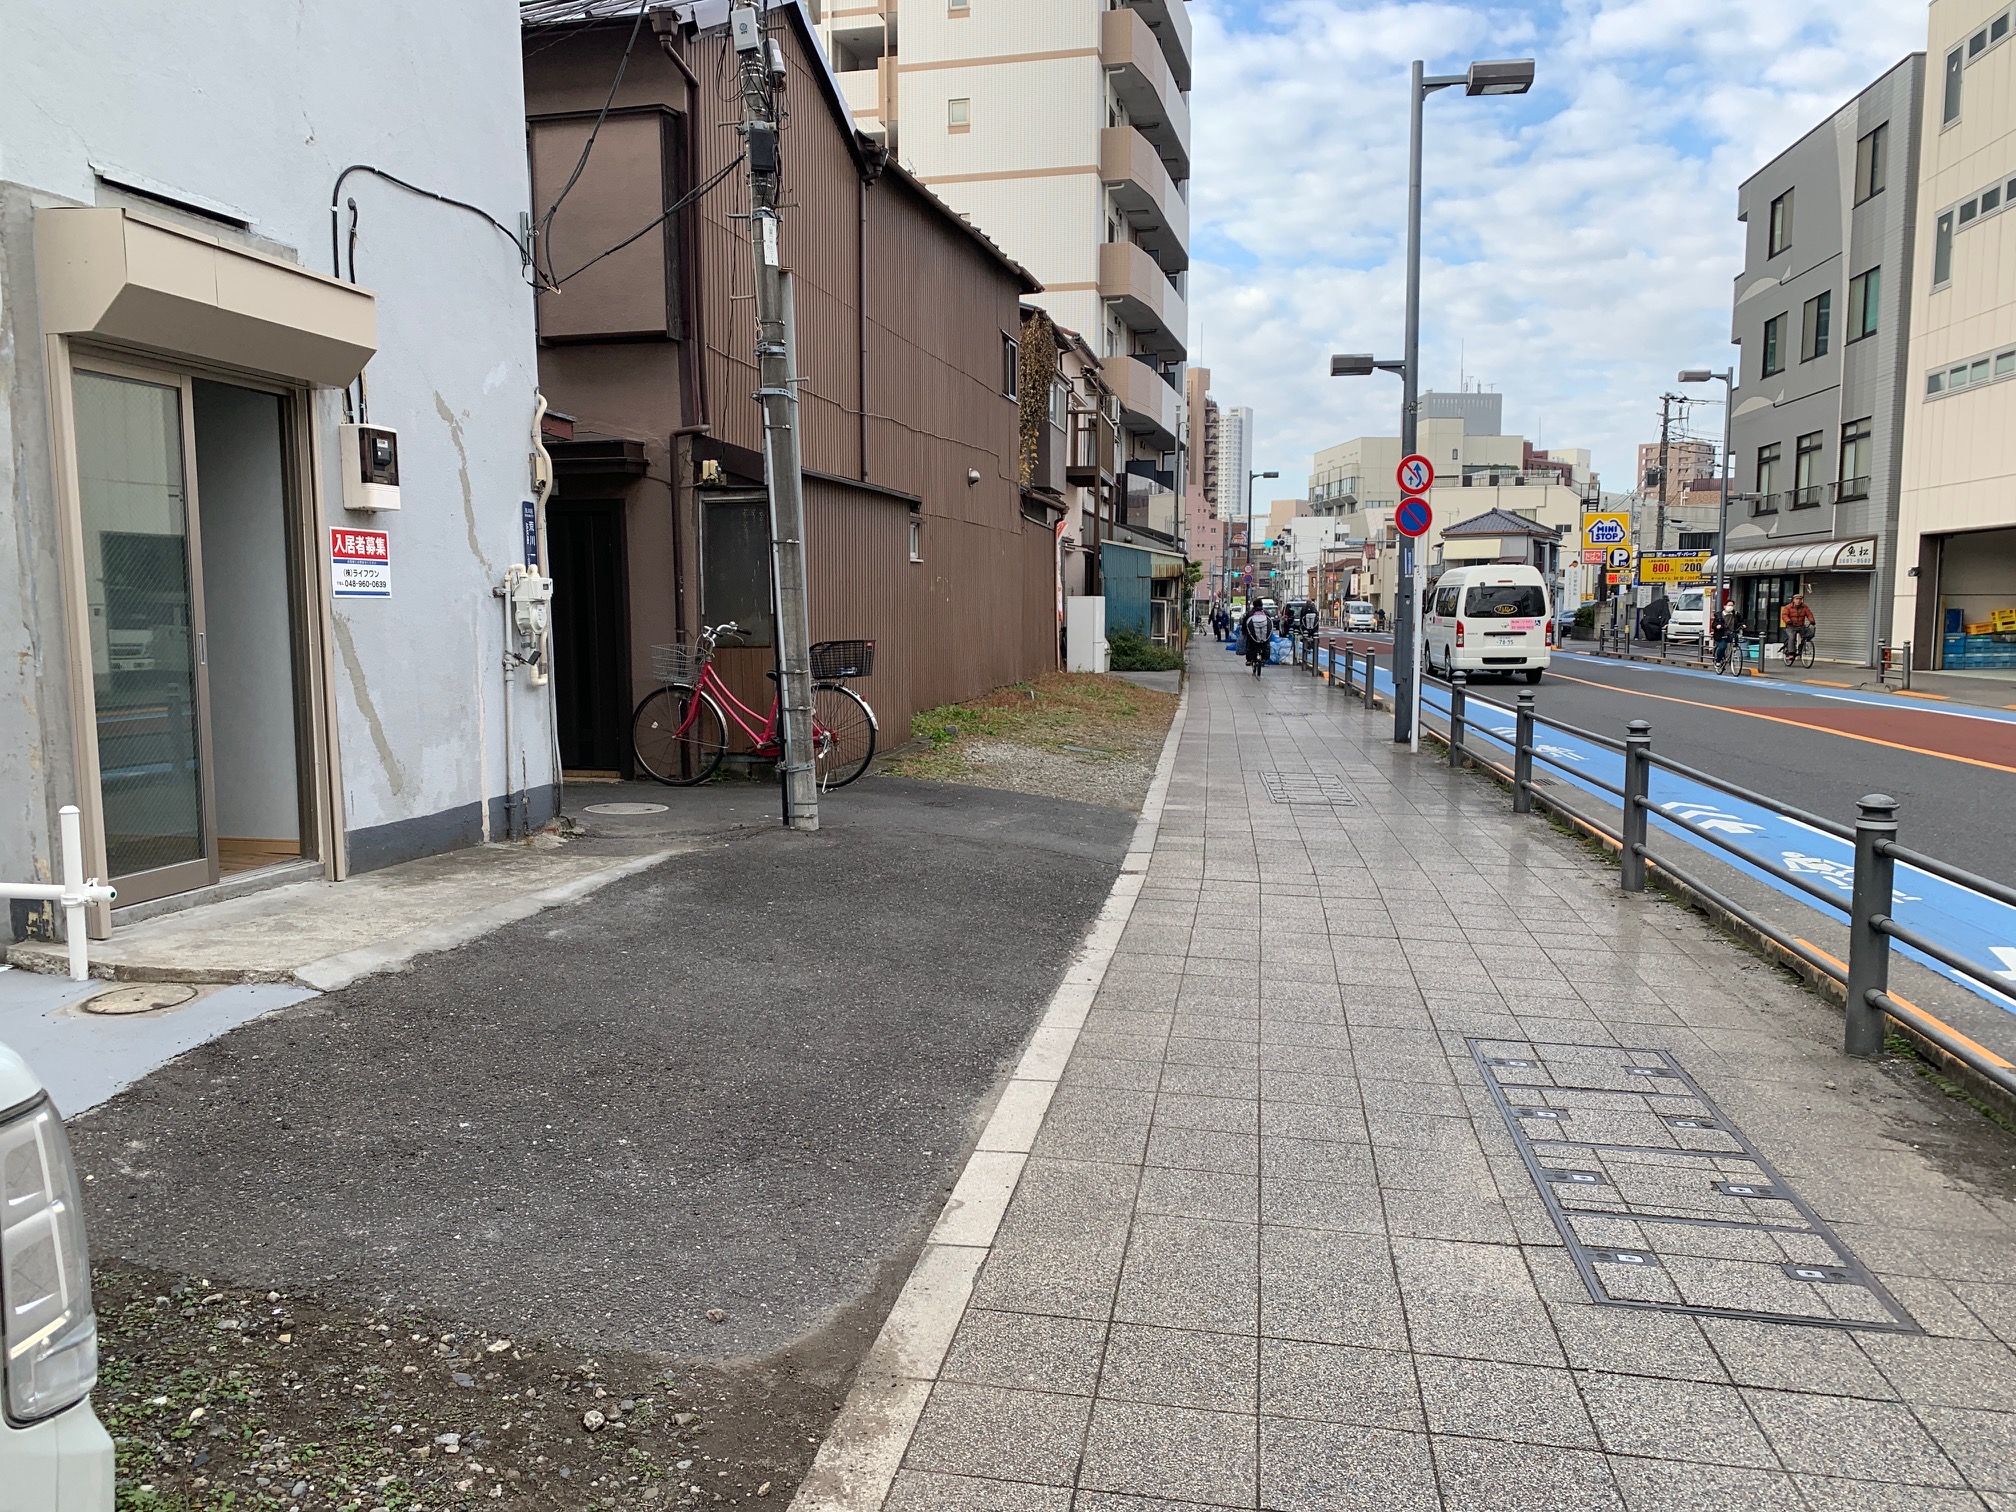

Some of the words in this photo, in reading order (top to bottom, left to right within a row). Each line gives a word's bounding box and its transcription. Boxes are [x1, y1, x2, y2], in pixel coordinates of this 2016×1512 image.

[334, 533, 386, 556] 入居者募集
[1846, 545, 1869, 557] 魚松
[1613, 549, 1628, 566] P
[344, 579, 387, 588] 048-960-0639
